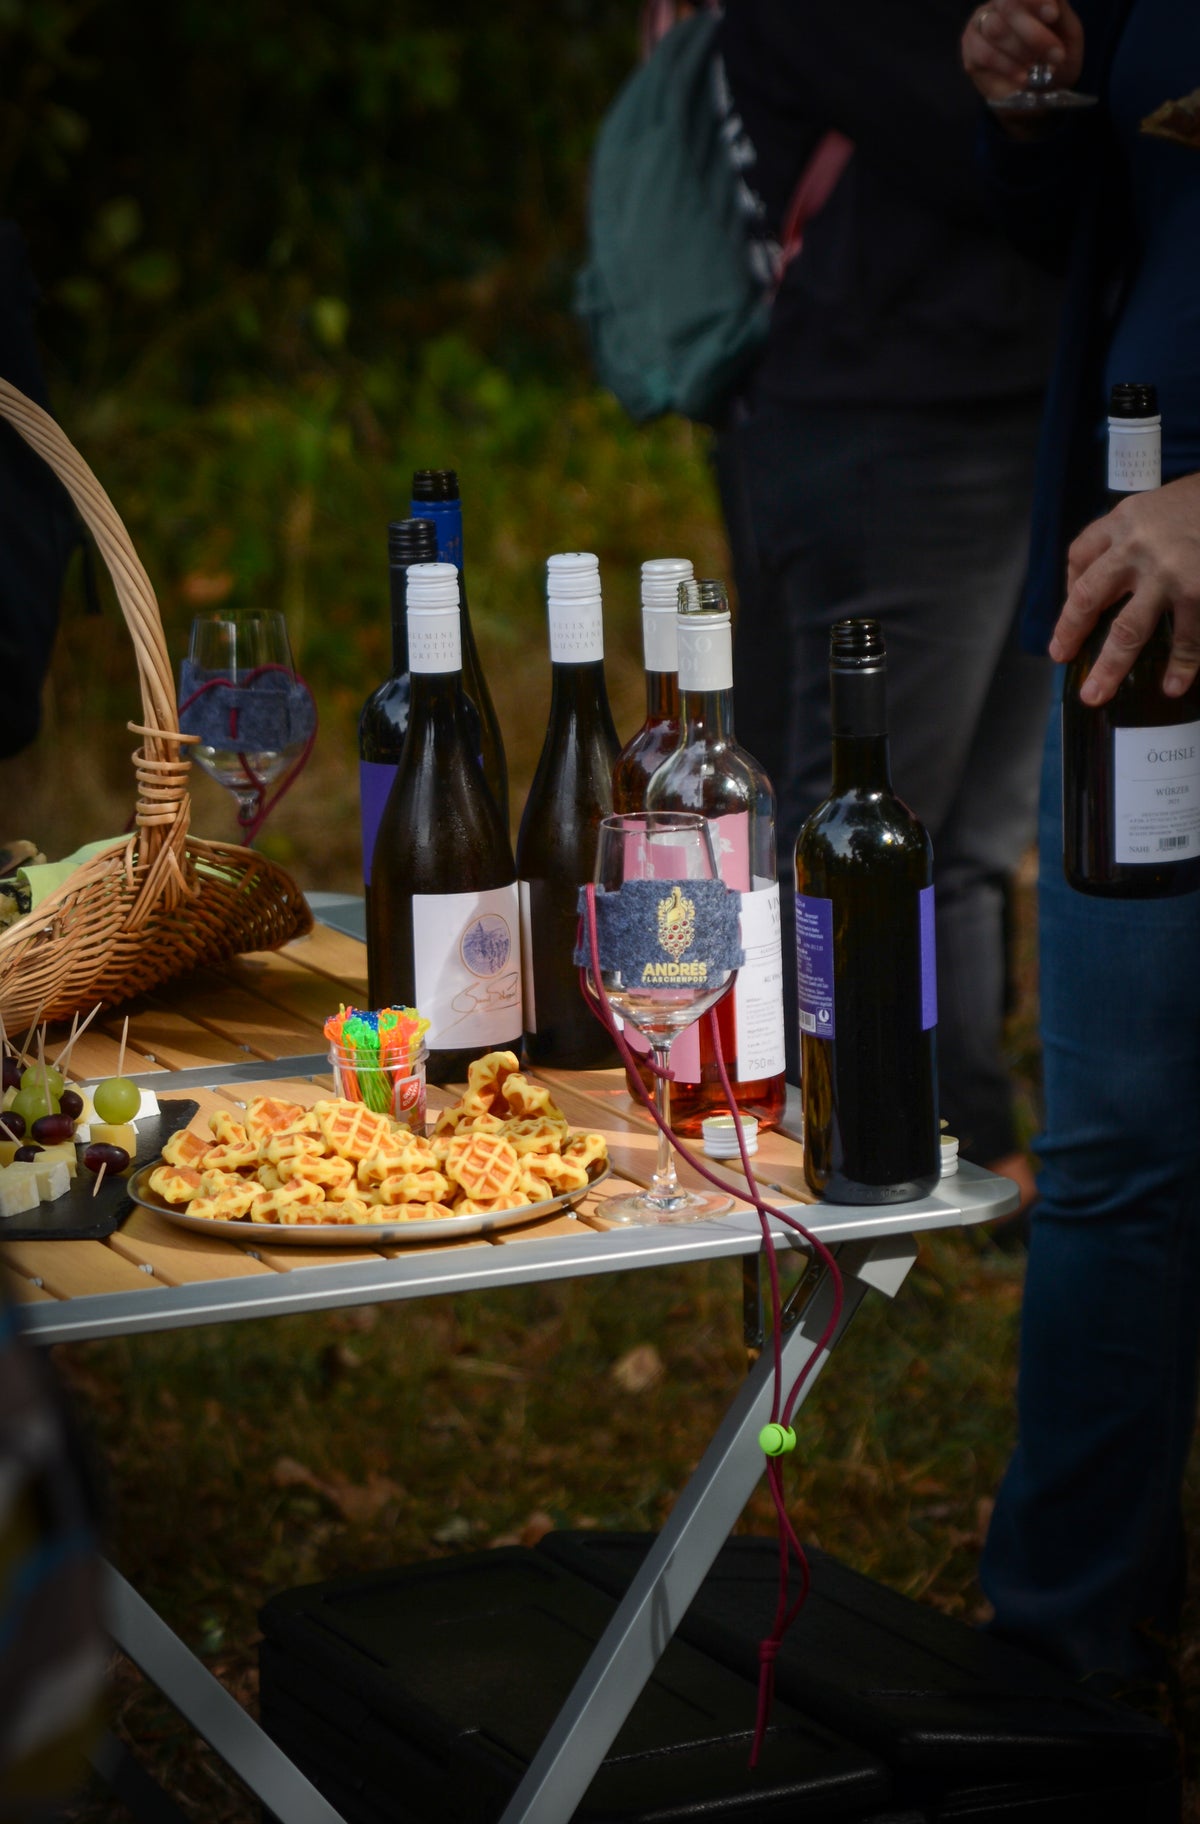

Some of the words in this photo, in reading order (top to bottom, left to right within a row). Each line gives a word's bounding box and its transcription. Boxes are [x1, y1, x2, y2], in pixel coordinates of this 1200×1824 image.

[1147, 746, 1195, 763] ÖCHSLE
[643, 959, 707, 976] ANDRÉS
[641, 976, 708, 984] FLASCHENPOST
[748, 1058, 766, 1070] 750
